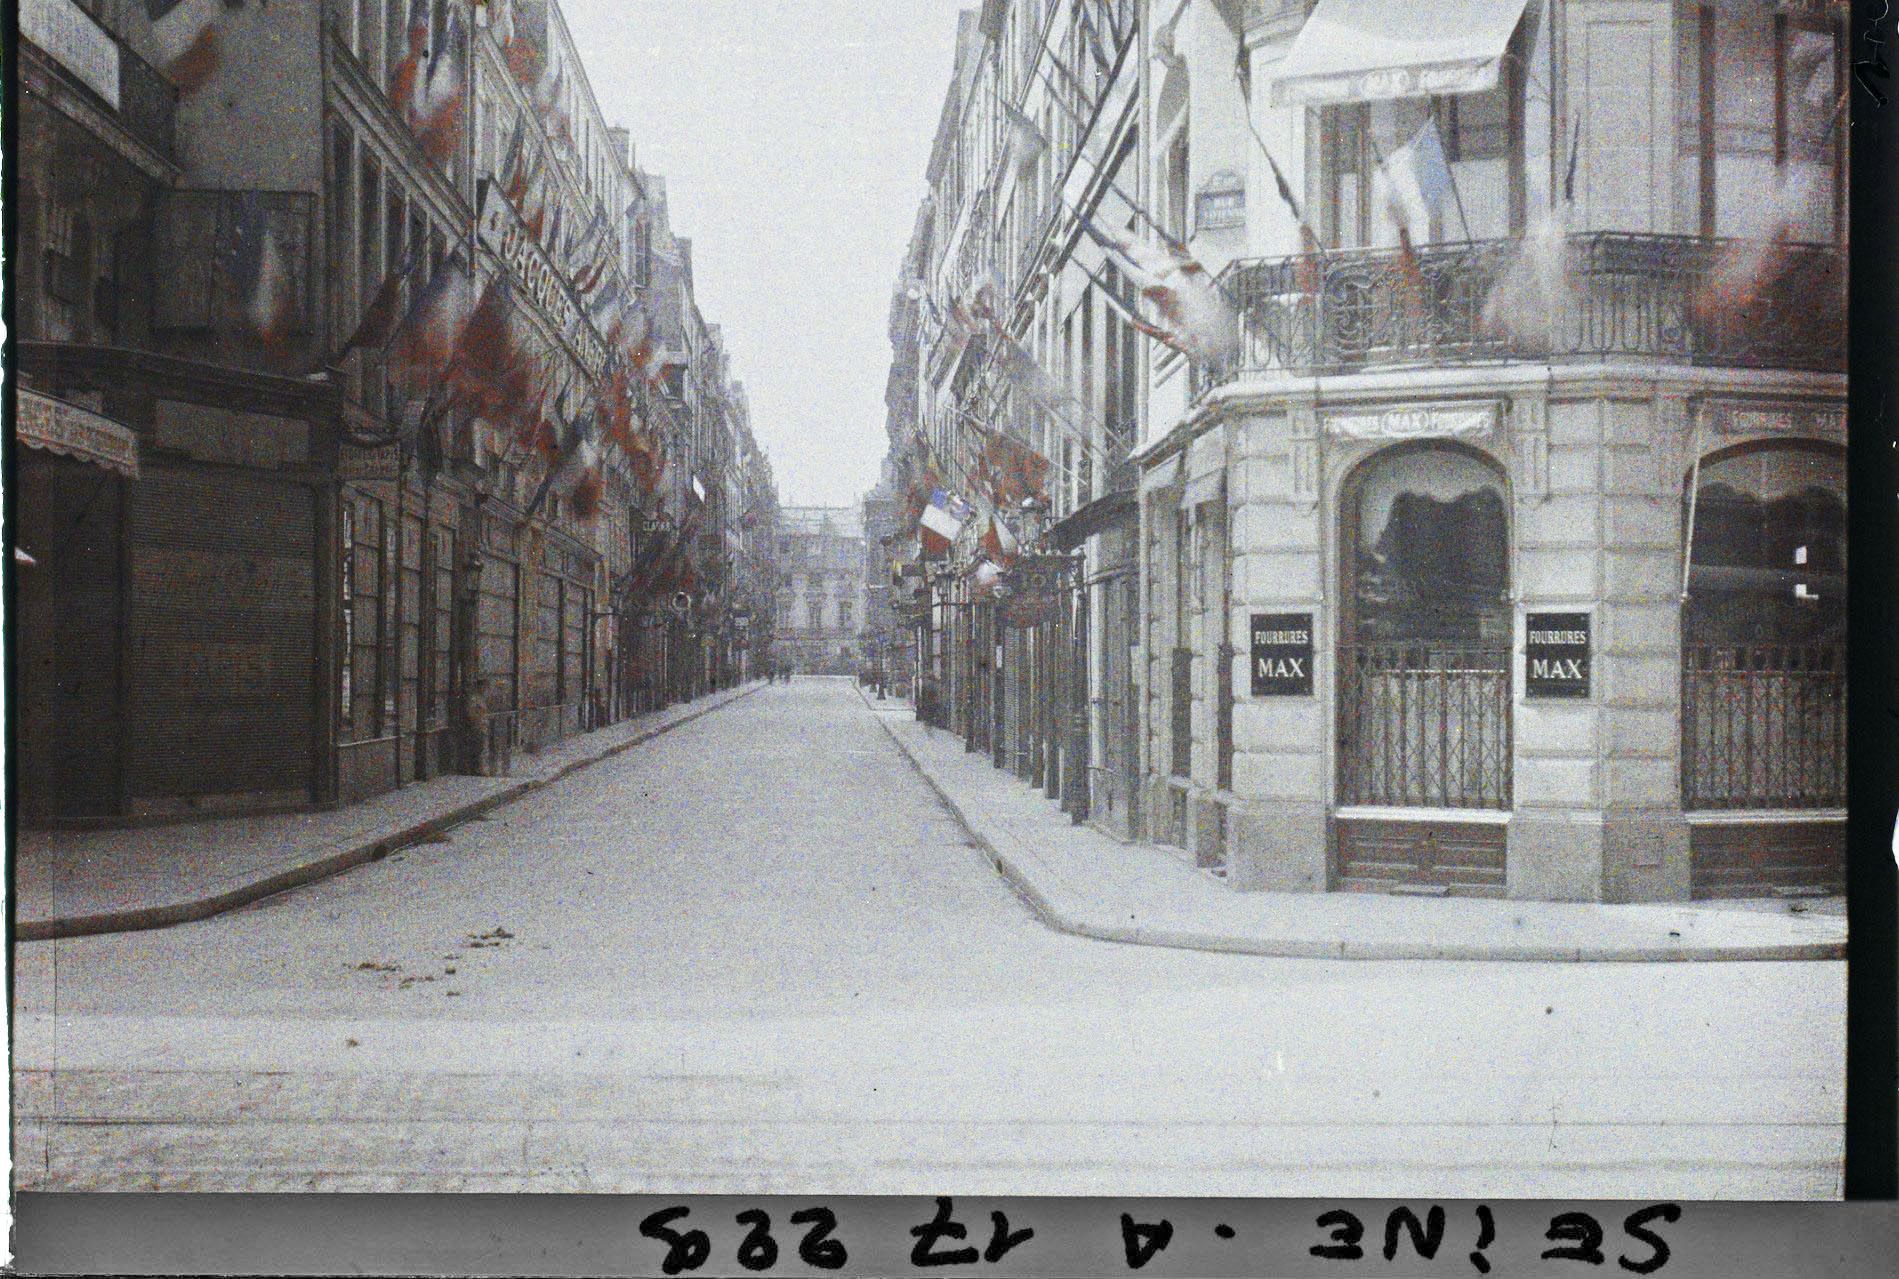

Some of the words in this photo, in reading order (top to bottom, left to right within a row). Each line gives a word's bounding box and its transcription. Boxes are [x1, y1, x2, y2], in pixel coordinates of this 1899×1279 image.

[502, 222, 576, 329] JACQUES
[1254, 630, 1309, 645] FOURRURES
[1529, 630, 1587, 645] FOURRURES
[1257, 658, 1305, 678] MAX
[1532, 658, 1584, 679] MAX
[640, 1206, 847, 1275] 229
[1121, 1213, 1173, 1268] A
